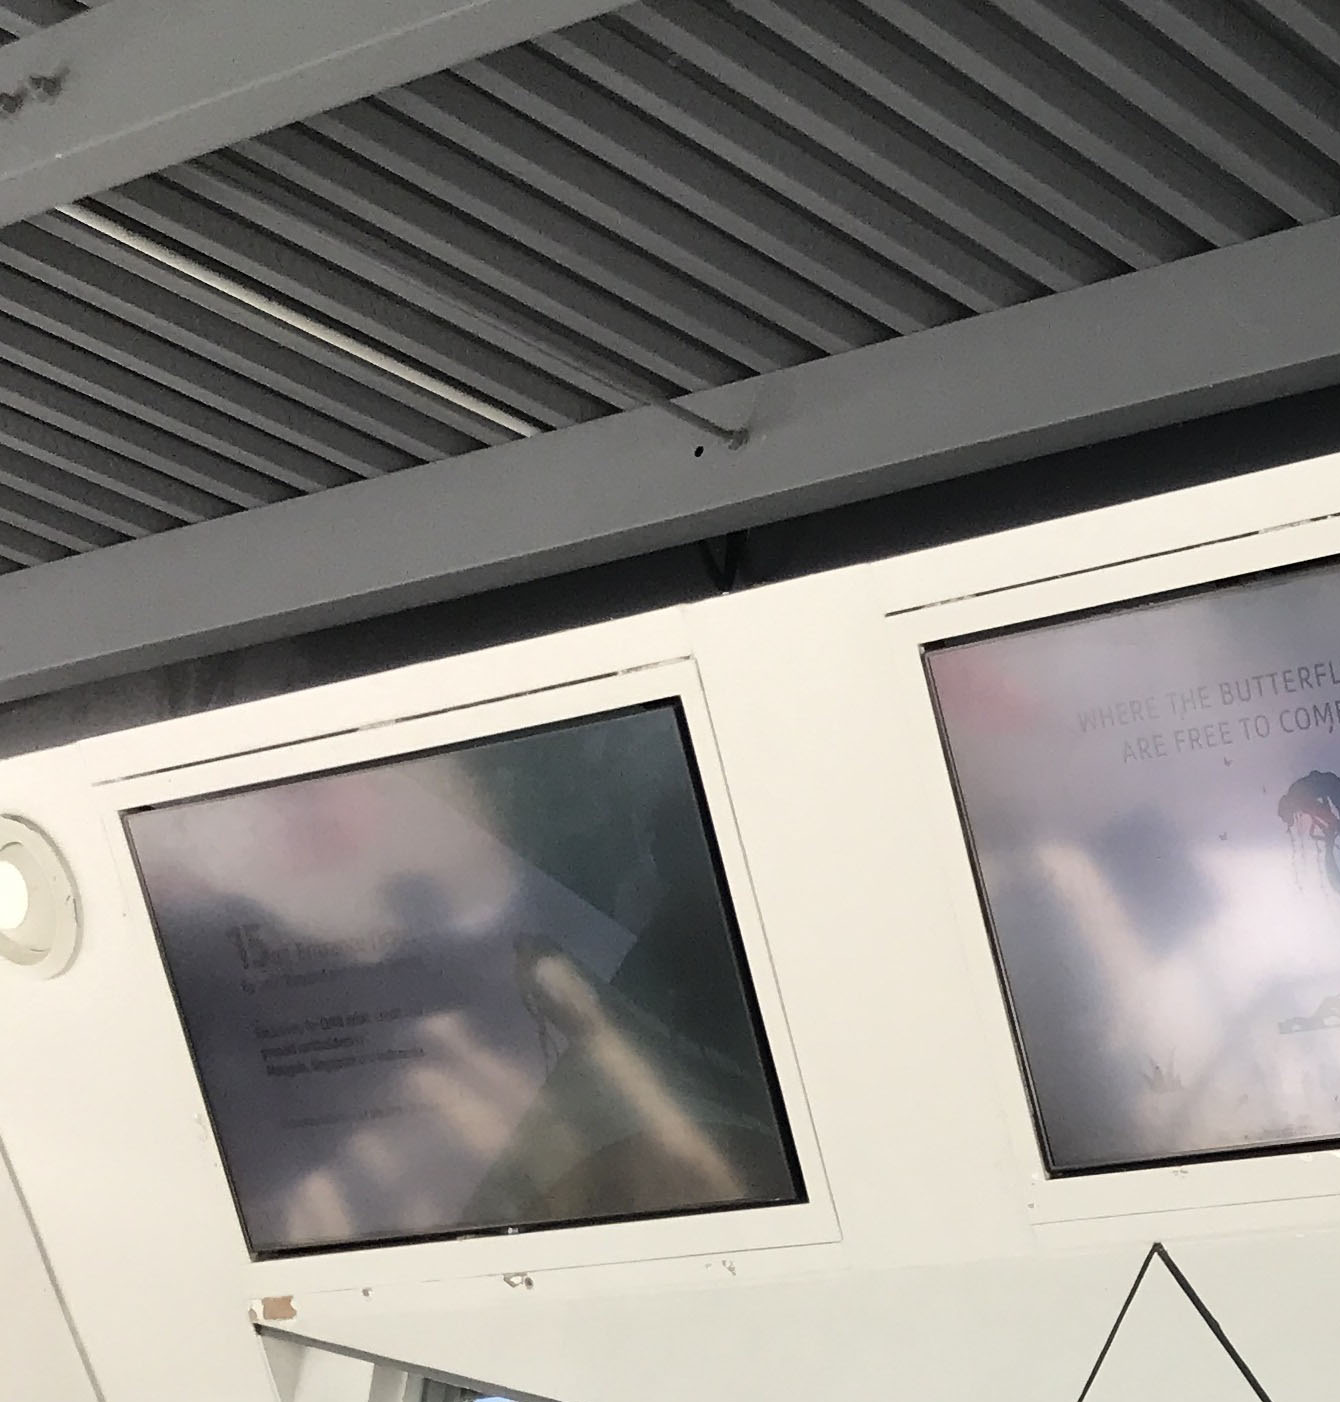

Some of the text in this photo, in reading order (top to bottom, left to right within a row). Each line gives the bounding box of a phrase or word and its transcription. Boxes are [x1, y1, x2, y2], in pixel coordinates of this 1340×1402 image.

[1077, 697, 1160, 733] WHERE
[1166, 686, 1212, 715] THE
[1124, 734, 1167, 763] ARE
[1174, 721, 1233, 753] FREE
[1239, 715, 1271, 741] TO
